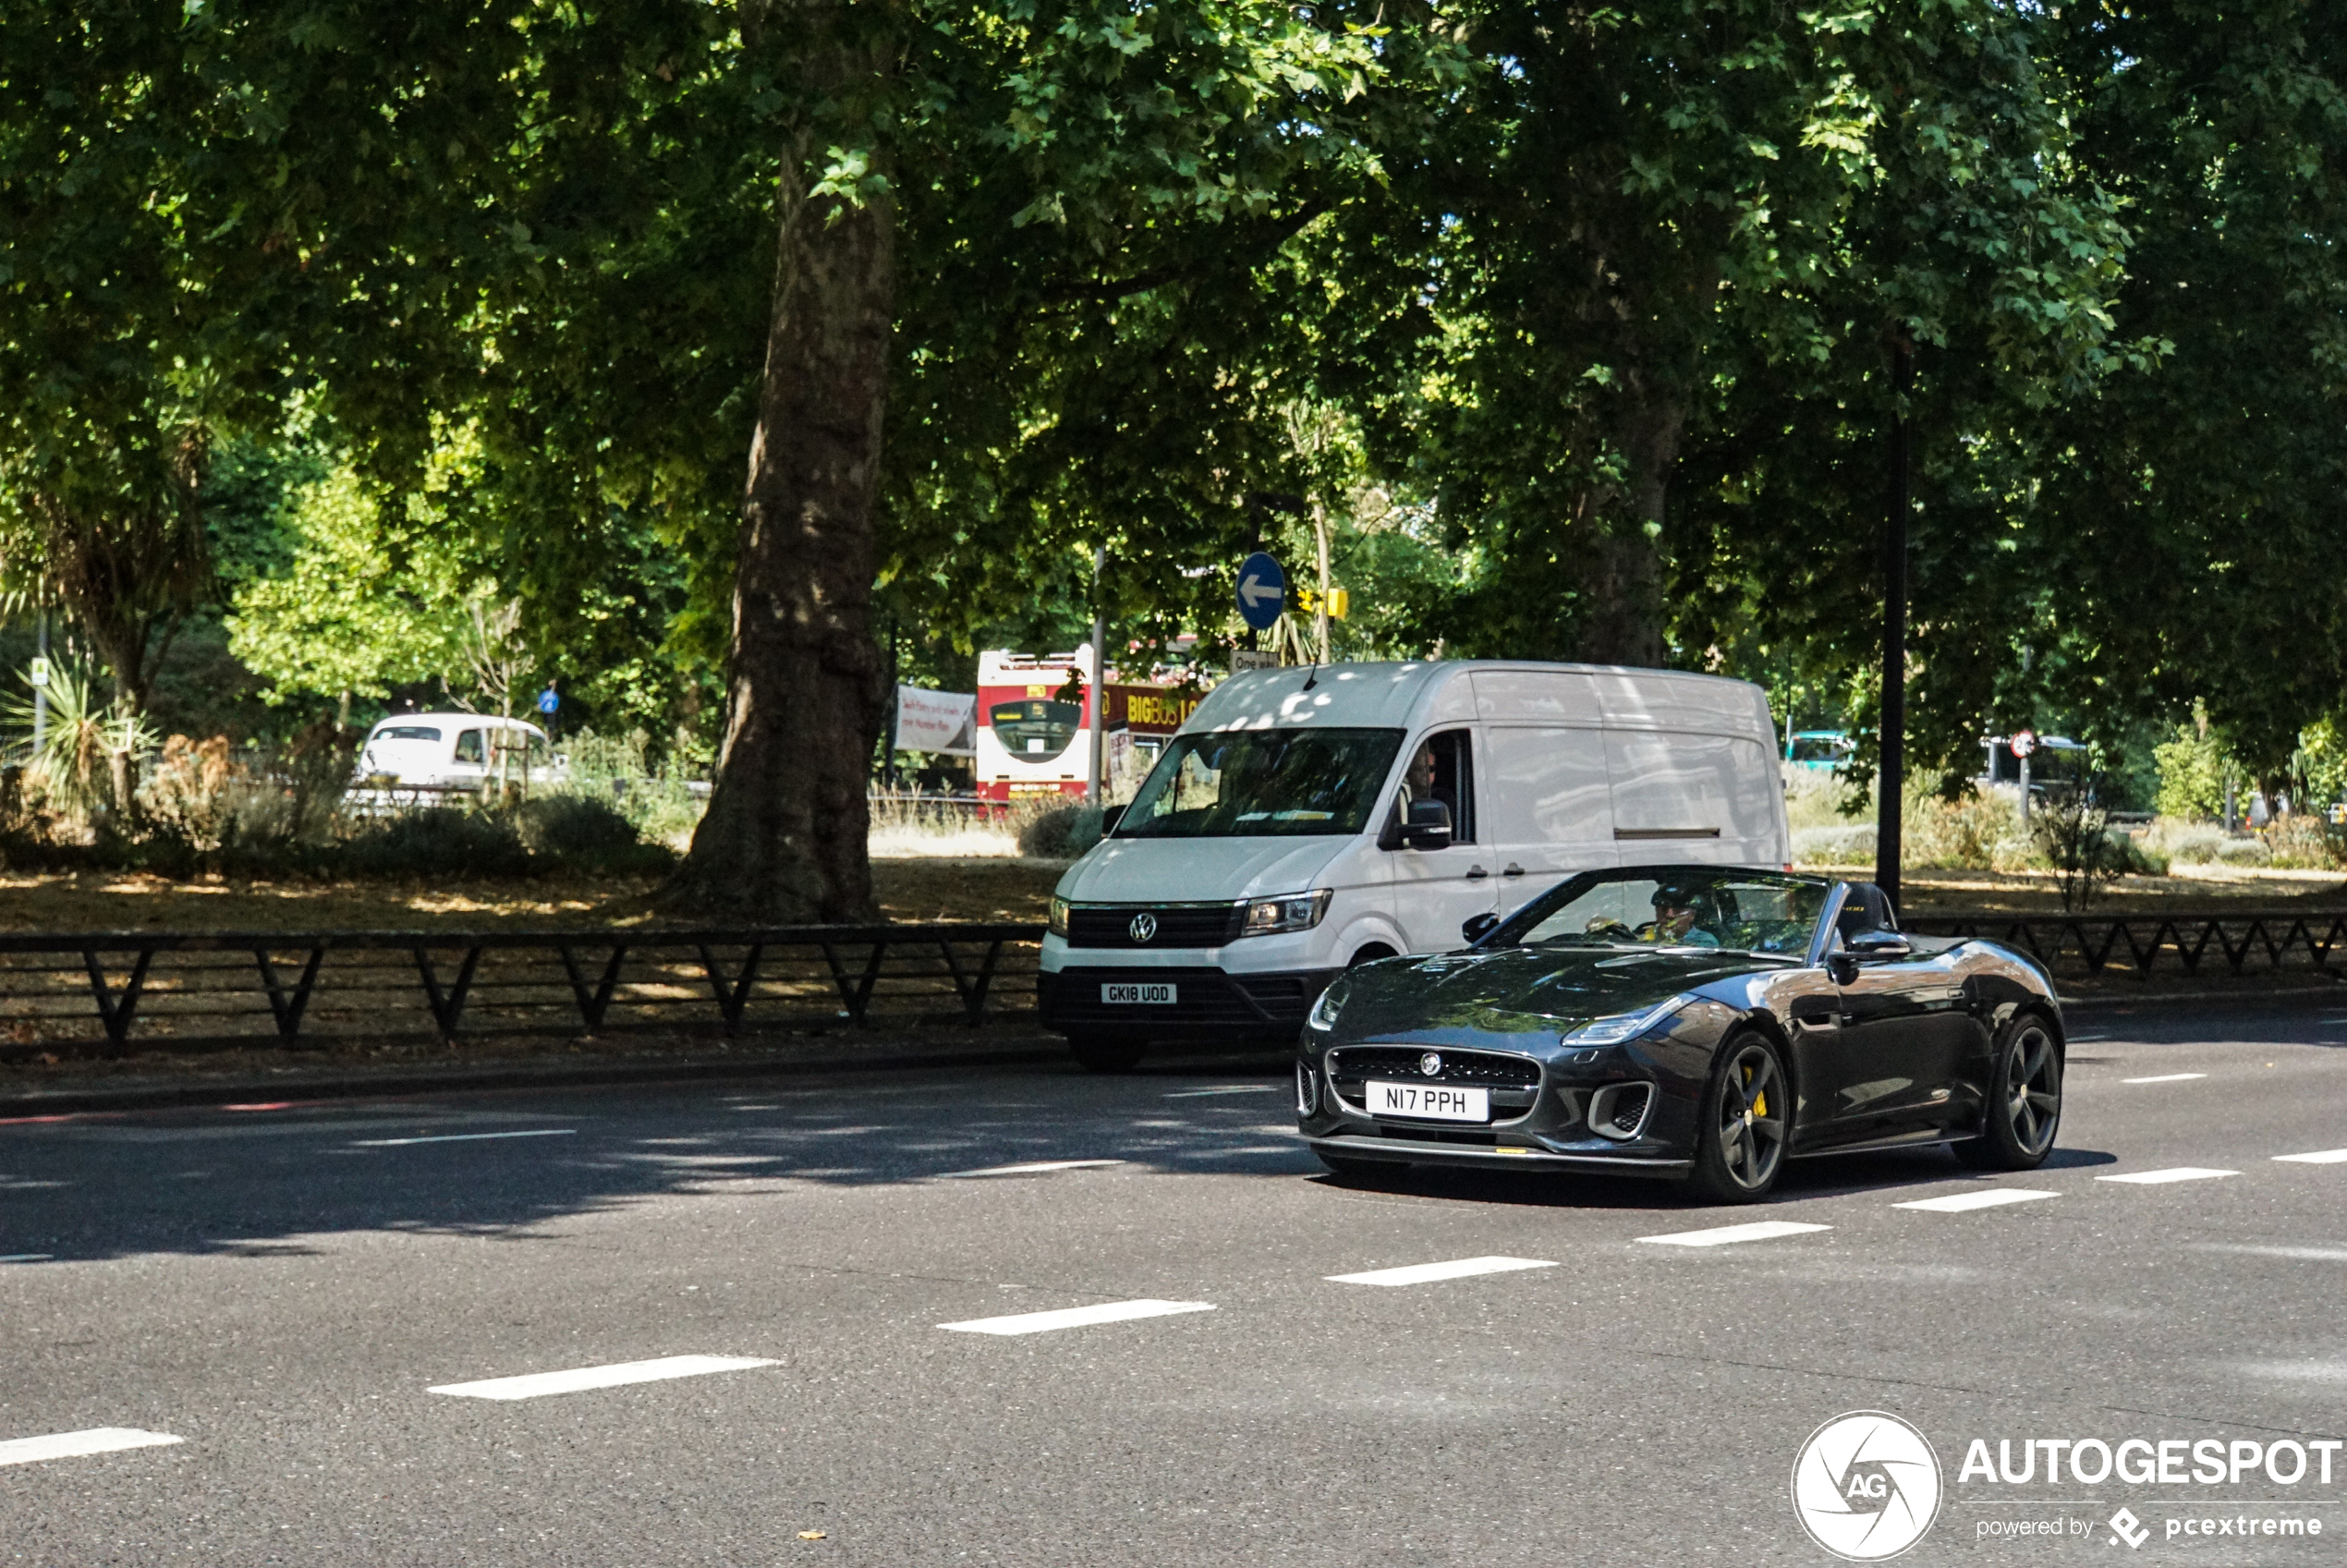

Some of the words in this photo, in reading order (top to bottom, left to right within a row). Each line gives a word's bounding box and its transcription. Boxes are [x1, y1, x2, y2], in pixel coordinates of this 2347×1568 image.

[1235, 656, 1256, 671] One
[1109, 986, 1138, 1001] GK18
[1142, 986, 1169, 1001] UOD
[1387, 1088, 1417, 1110] N17
[1425, 1090, 1465, 1113] PPH
